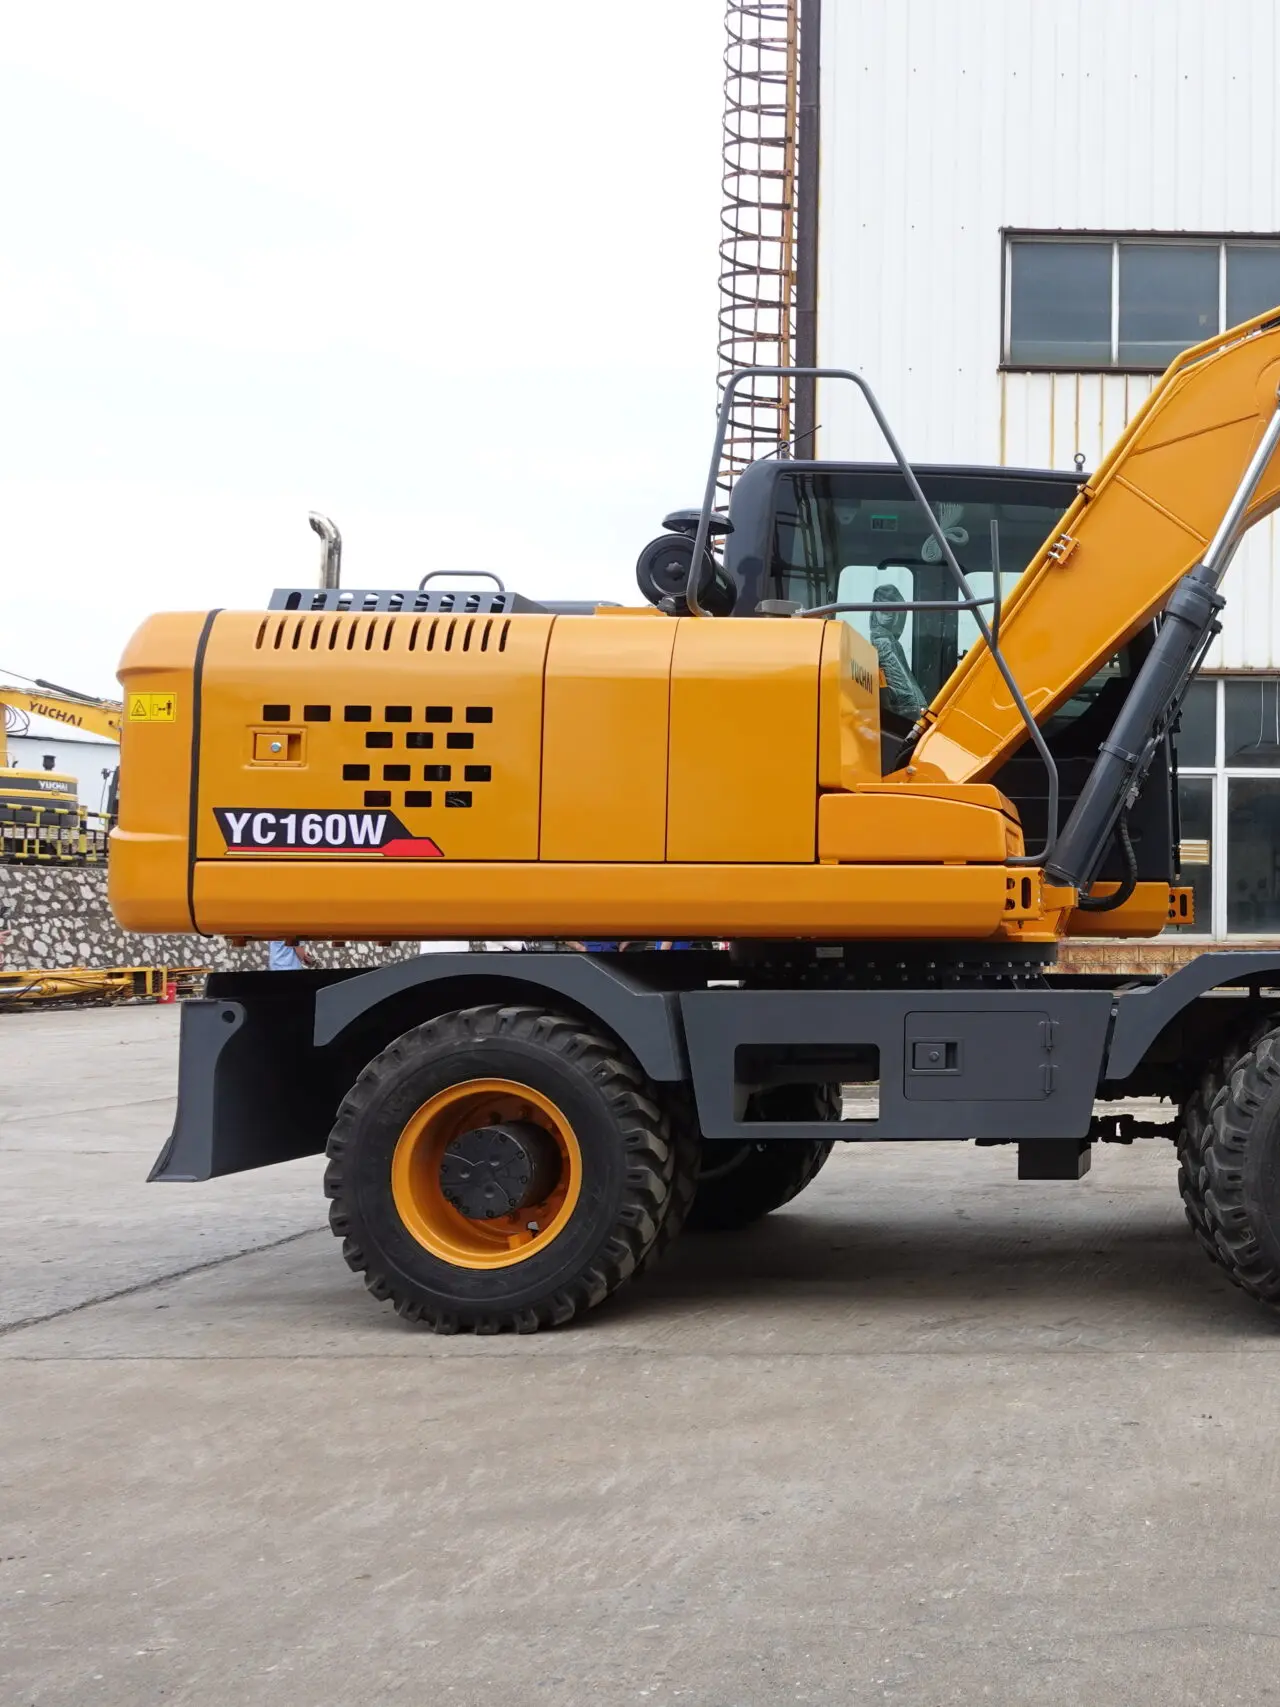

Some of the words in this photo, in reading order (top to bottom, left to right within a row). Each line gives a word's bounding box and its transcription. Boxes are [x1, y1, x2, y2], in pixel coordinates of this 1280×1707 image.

[851, 658, 873, 695] YUCHAI
[29, 701, 83, 727] YUCHAI
[39, 780, 68, 791] YUCHAI
[224, 812, 387, 845] YC160W
